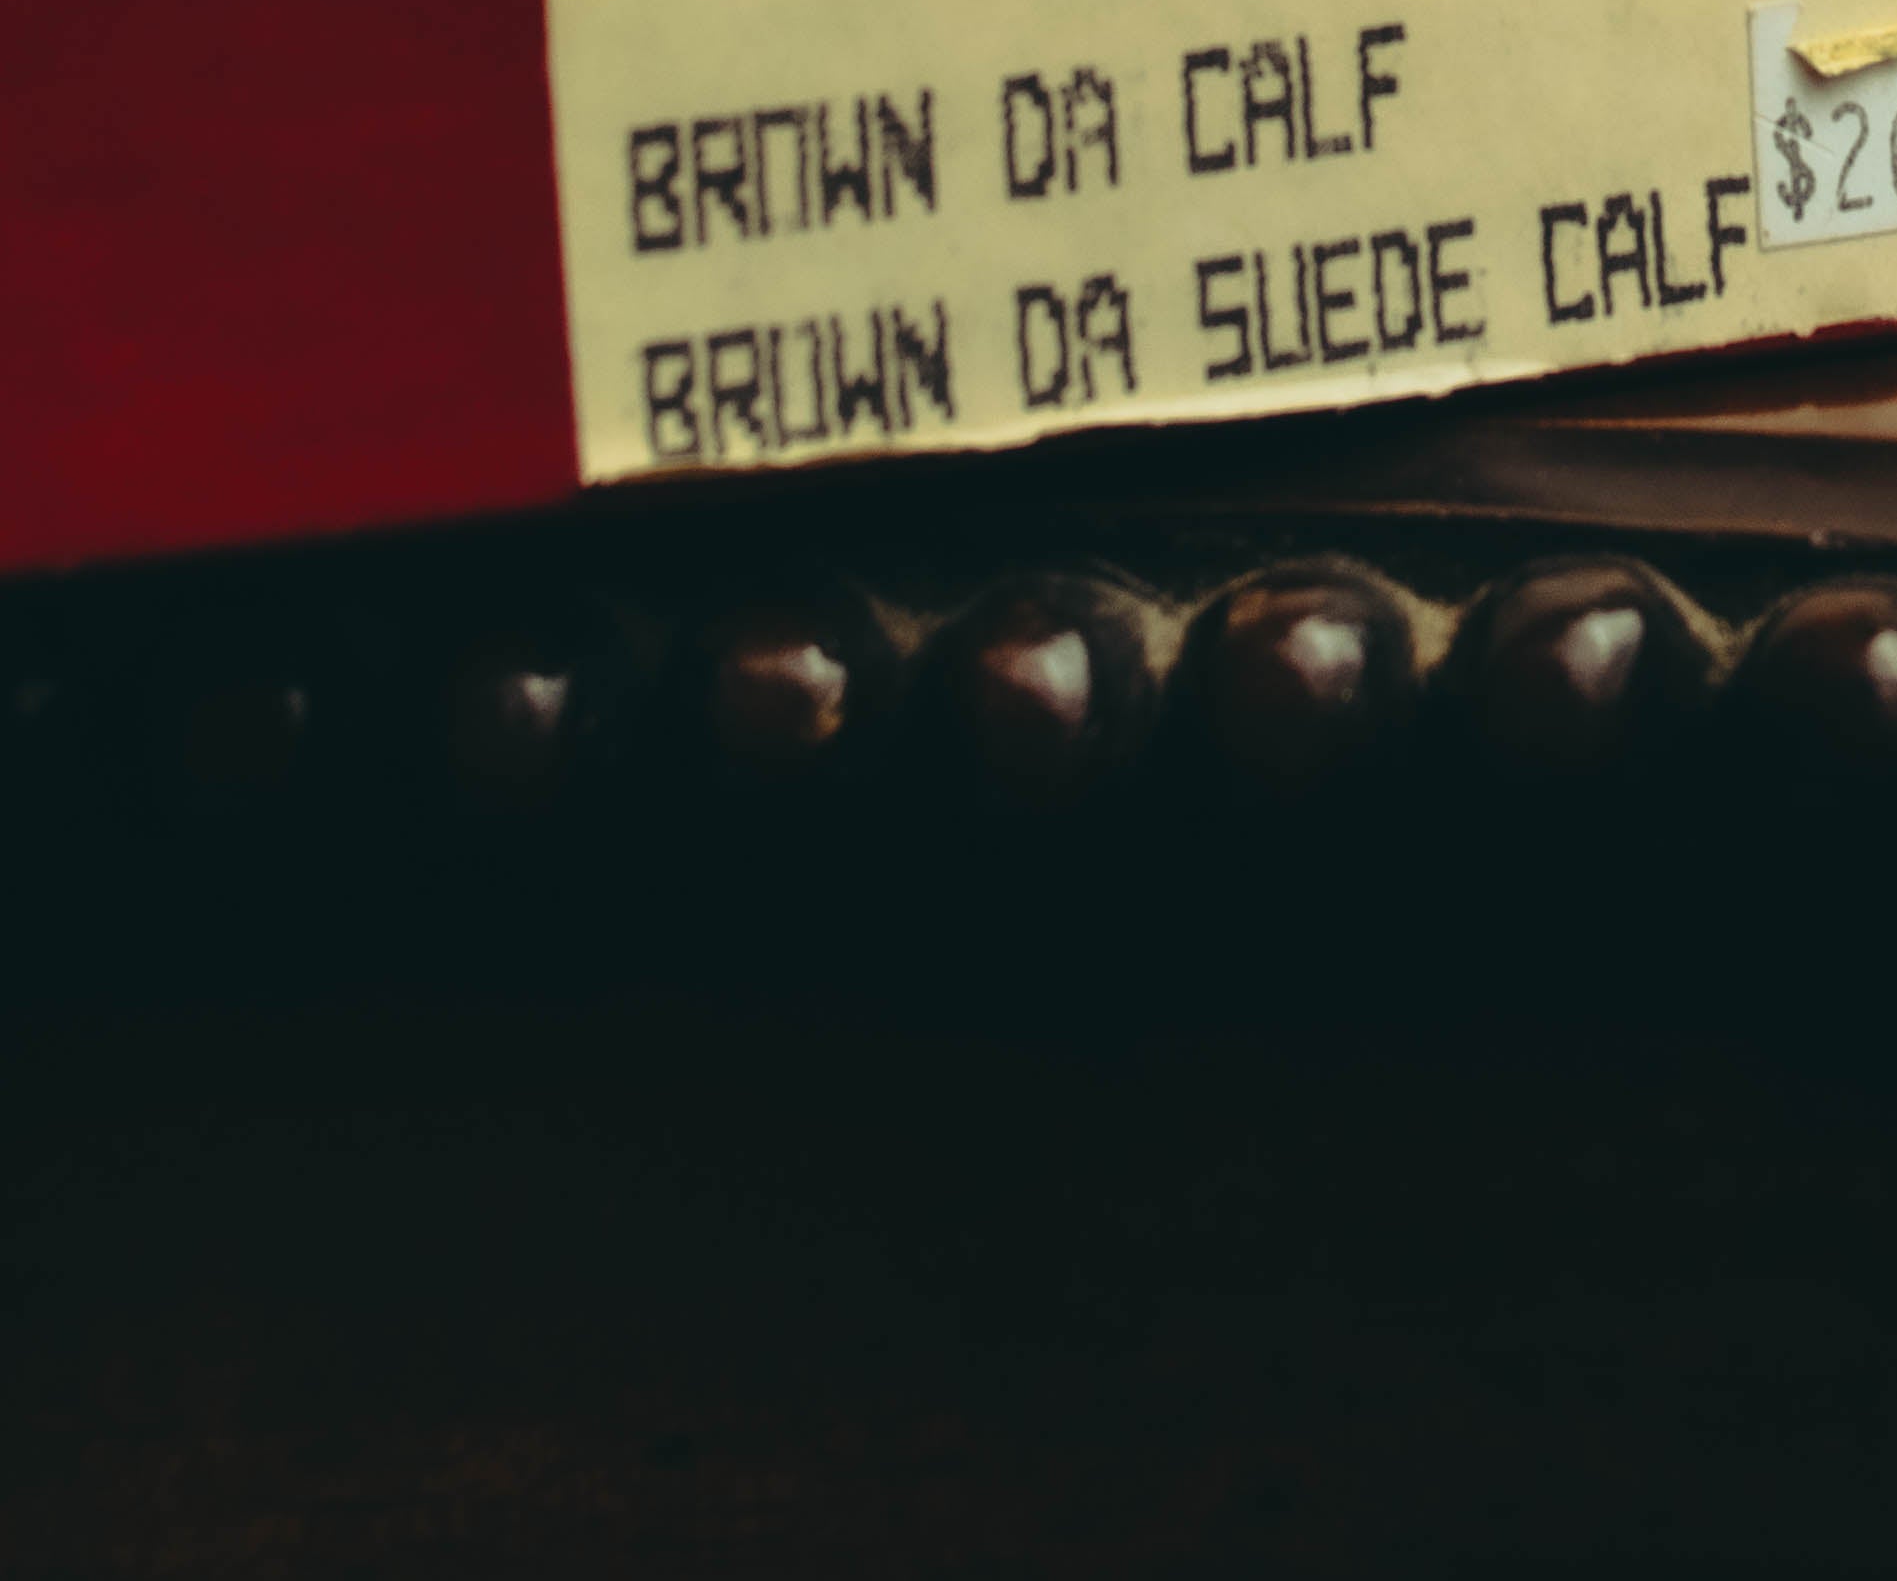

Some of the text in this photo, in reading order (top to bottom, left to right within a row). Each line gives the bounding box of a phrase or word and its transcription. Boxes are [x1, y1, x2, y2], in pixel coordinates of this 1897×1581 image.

[627, 22, 1405, 254] BROWN DA CALF
[643, 174, 1752, 463] BROWN DA SUEDE CALF
